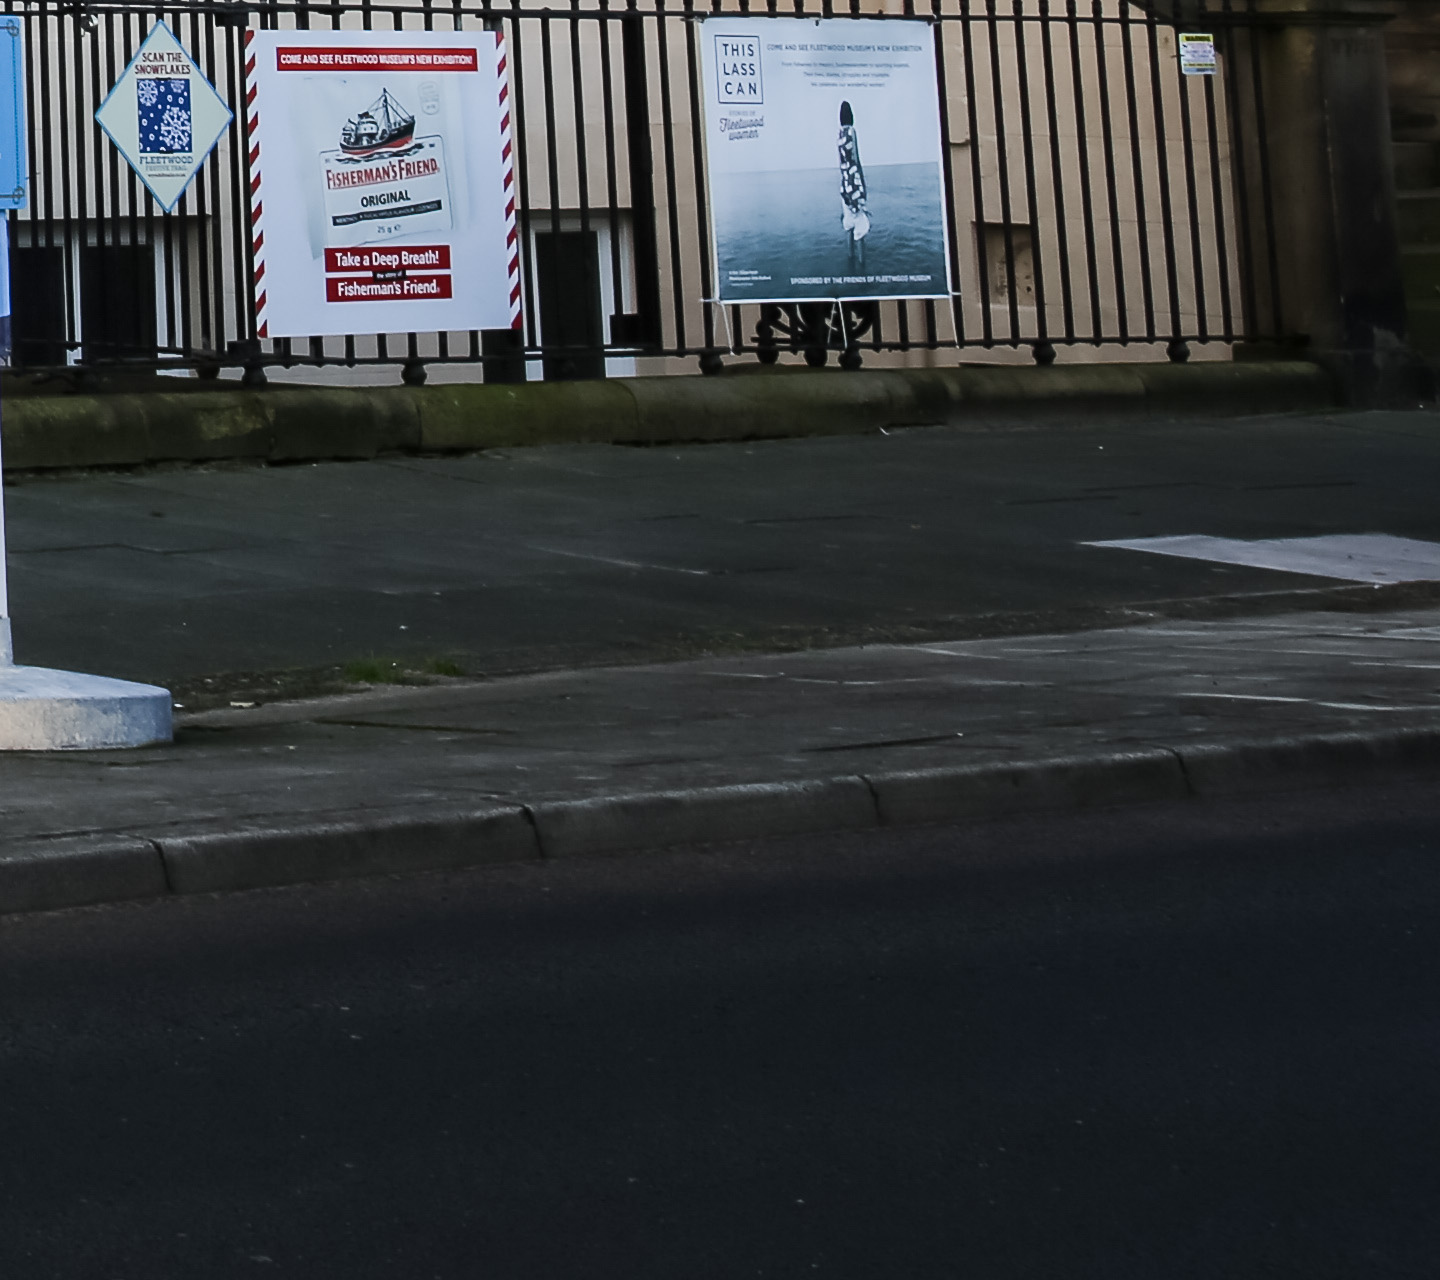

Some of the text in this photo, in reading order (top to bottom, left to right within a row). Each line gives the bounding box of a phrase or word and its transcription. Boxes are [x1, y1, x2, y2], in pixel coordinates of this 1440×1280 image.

[723, 44, 754, 56] THIS
[142, 52, 182, 62] SCAN THE
[280, 54, 302, 64] COME
[303, 54, 318, 64] AND
[319, 54, 334, 64] SEE
[334, 54, 378, 64] FLEETWOOD
[416, 55, 432, 65] NEW
[134, 64, 191, 75] SNOWFLAKES
[723, 63, 756, 76] LASS
[725, 82, 757, 95] CAN
[139, 156, 194, 164] FLEETWOOD
[326, 161, 397, 189] FISHERMAN'S
[361, 190, 411, 207] ORIGINAL
[335, 249, 439, 268] Take a Deep Breath!
[337, 281, 401, 296] Fisherman's
